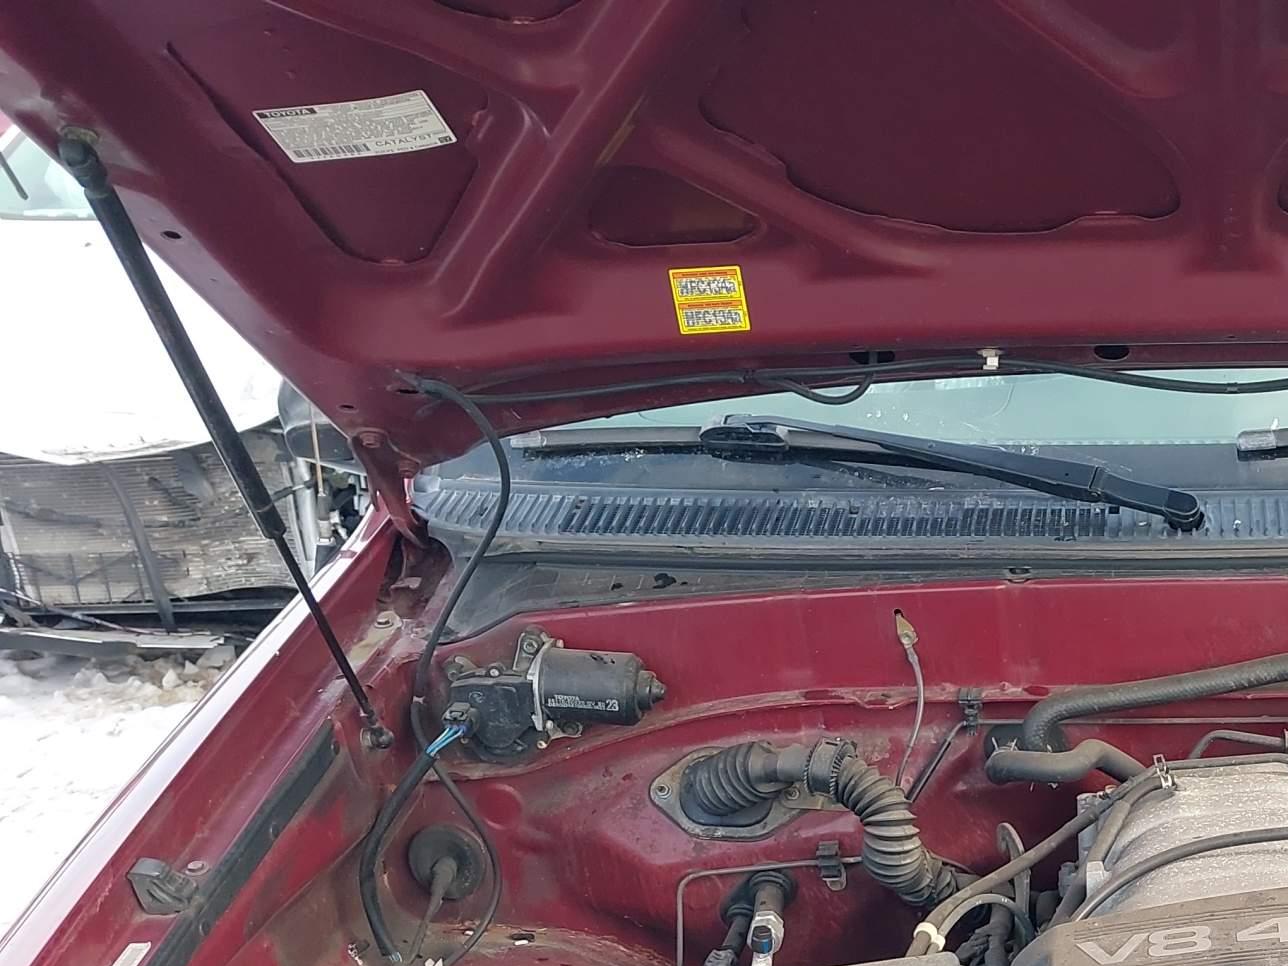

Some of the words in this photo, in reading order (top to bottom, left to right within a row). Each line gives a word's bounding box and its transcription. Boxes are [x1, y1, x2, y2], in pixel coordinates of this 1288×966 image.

[264, 108, 309, 118] TOYOTA
[375, 133, 432, 147] CATALYST
[606, 699, 619, 711] 23
[1076, 925, 1213, 965] V8
